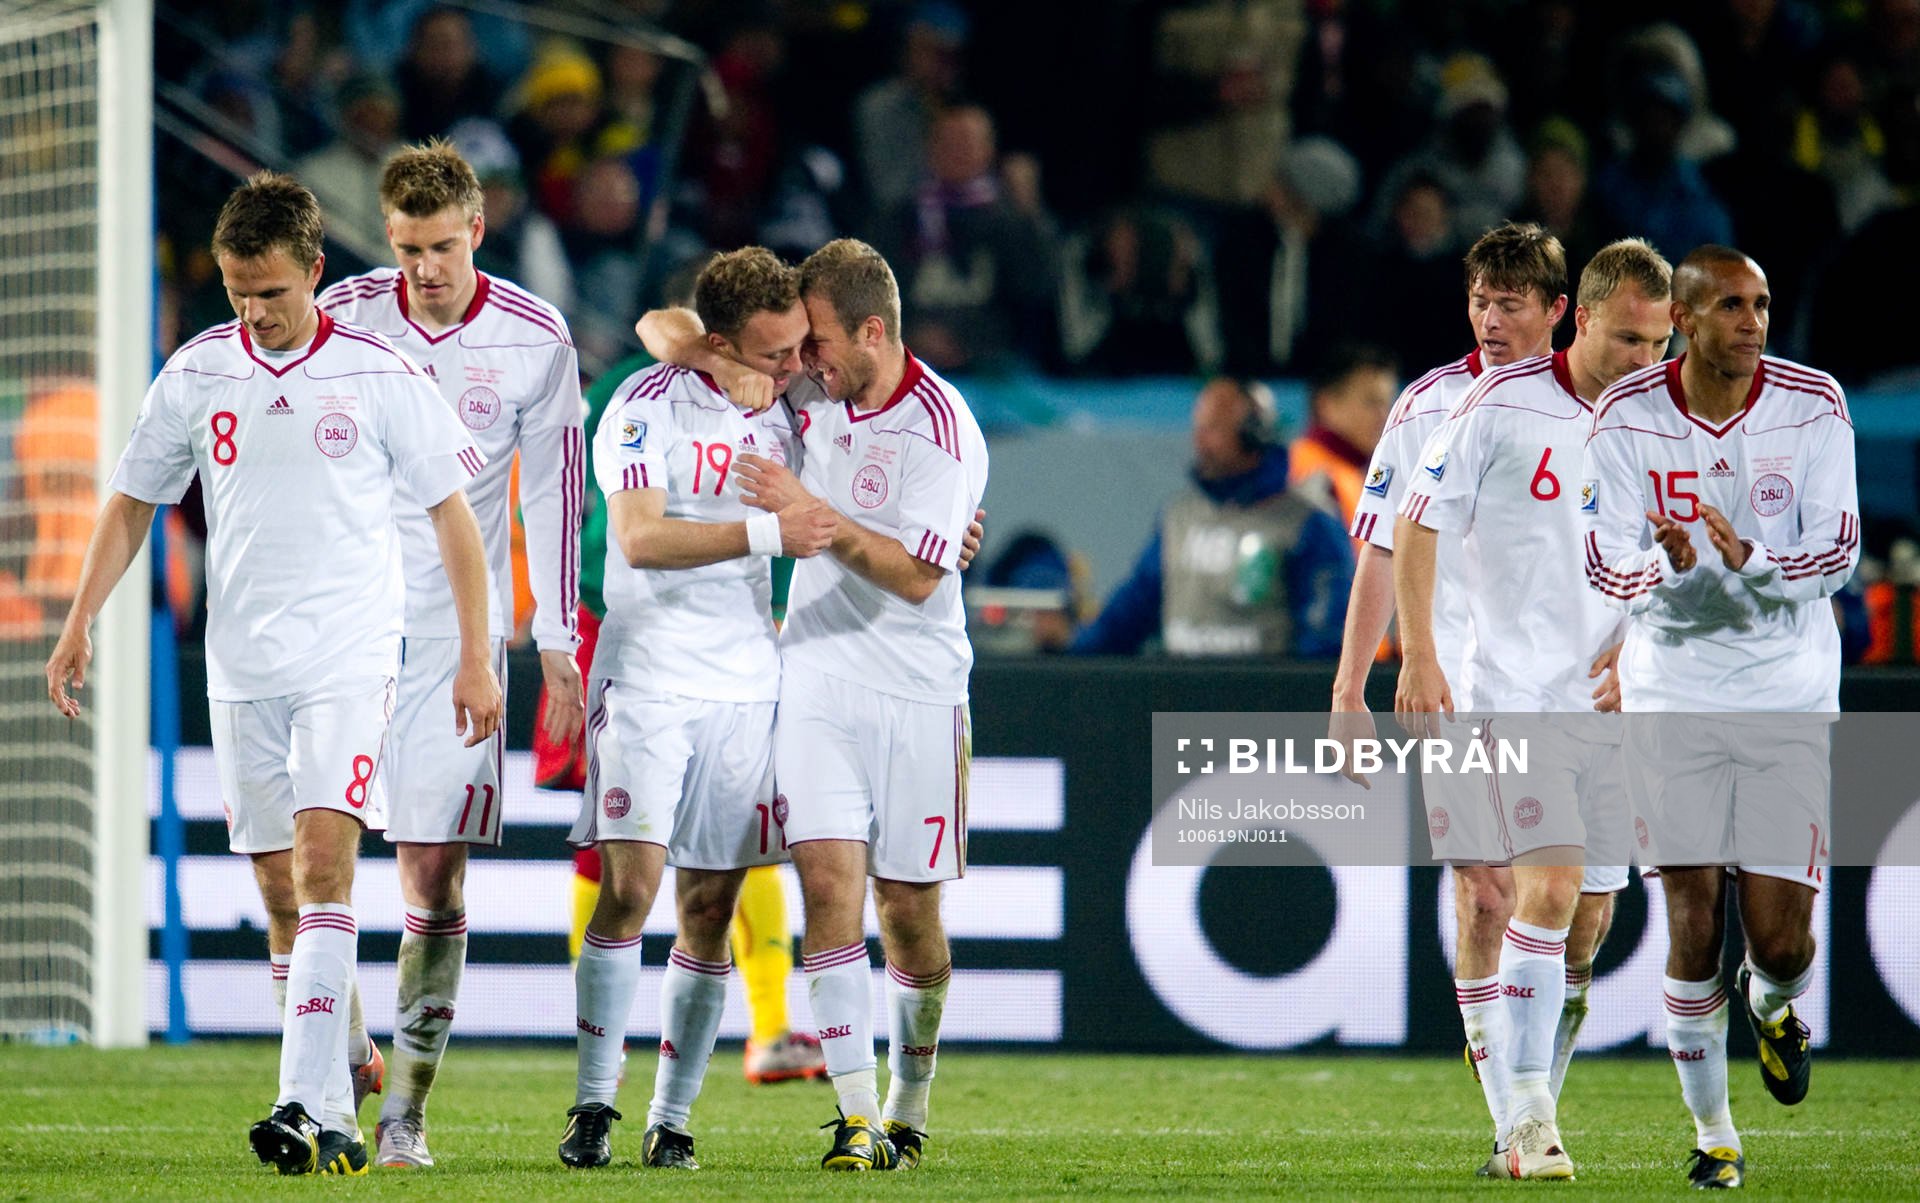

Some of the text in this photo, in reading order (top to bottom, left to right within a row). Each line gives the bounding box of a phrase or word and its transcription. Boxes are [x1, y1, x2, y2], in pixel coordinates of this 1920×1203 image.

[266, 408, 294, 416] adidas
[468, 401, 492, 414] DBU
[210, 410, 238, 467] 8
[325, 428, 348, 441] DBU
[692, 440, 733, 496] 19
[1529, 447, 1561, 502] 6
[1706, 470, 1735, 479] adidas
[860, 478, 880, 494] DBU
[1760, 488, 1784, 502] DBU
[1647, 469, 1700, 524] 15
[344, 754, 374, 809] 8
[458, 783, 493, 837] 11
[607, 797, 625, 809] DBU
[924, 815, 946, 869] 7
[296, 996, 335, 1017] DBU
[818, 1024, 852, 1040] DBU
